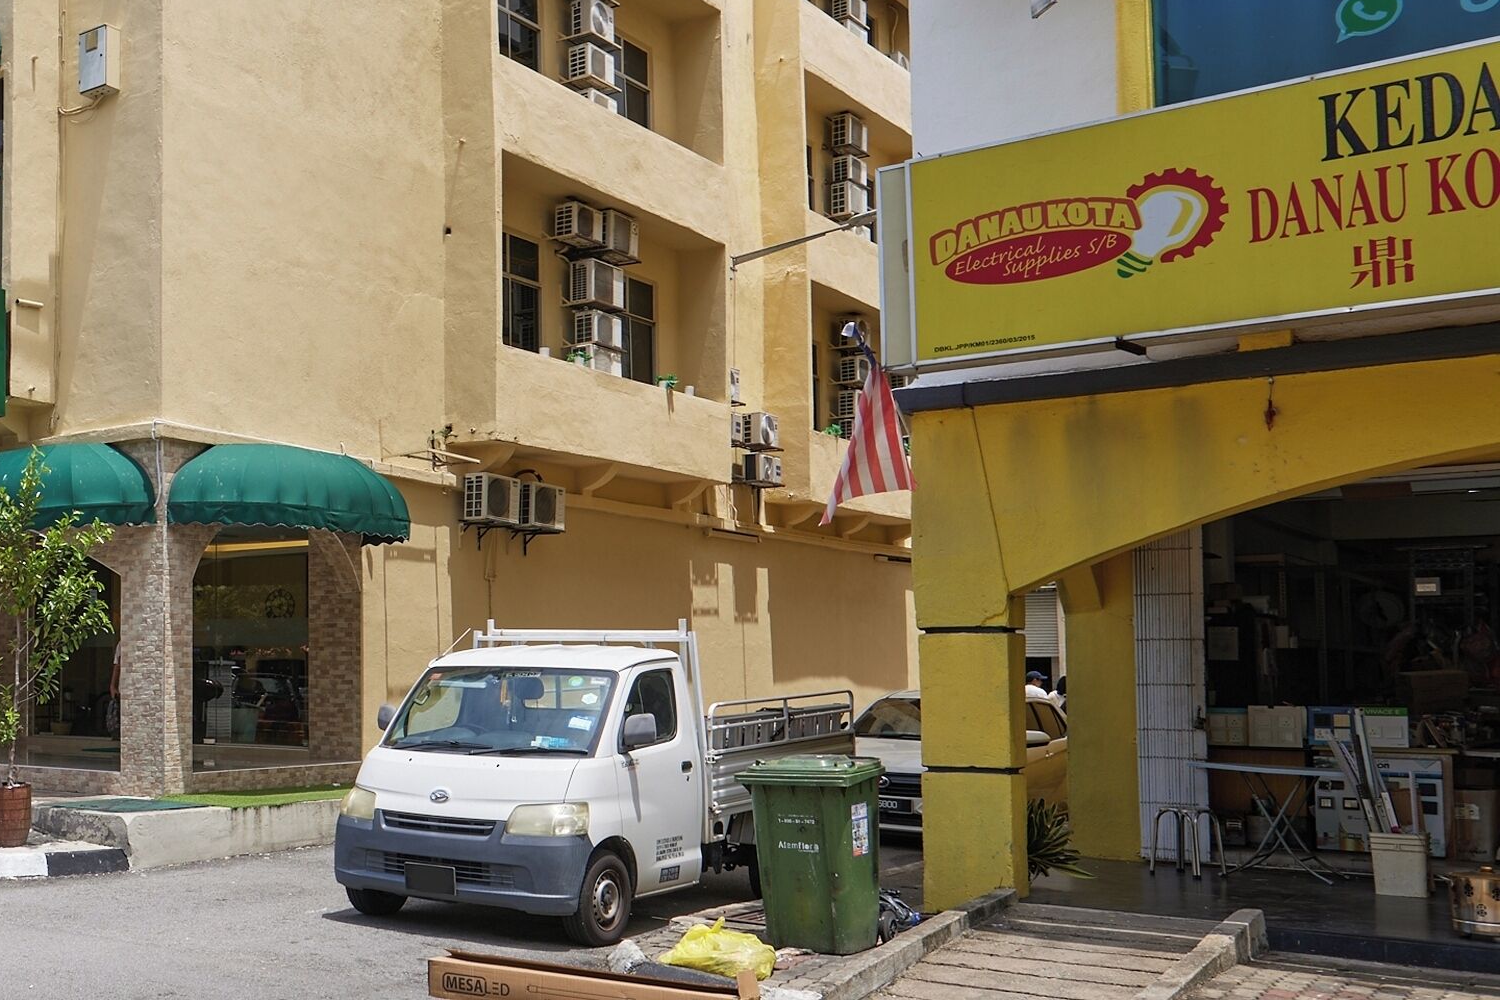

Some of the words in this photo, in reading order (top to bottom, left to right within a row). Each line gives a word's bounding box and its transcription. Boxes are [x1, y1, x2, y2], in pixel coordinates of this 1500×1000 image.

[1318, 62, 1500, 161] KEDA
[929, 202, 1044, 265] DANAU
[1046, 198, 1141, 230] KOTA
[1247, 163, 1409, 243] DANAU
[955, 236, 1045, 275] Electrical
[1002, 245, 1081, 278] Supplies
[1088, 233, 1117, 254] S/B
[1350, 236, 1415, 289] 鼎
